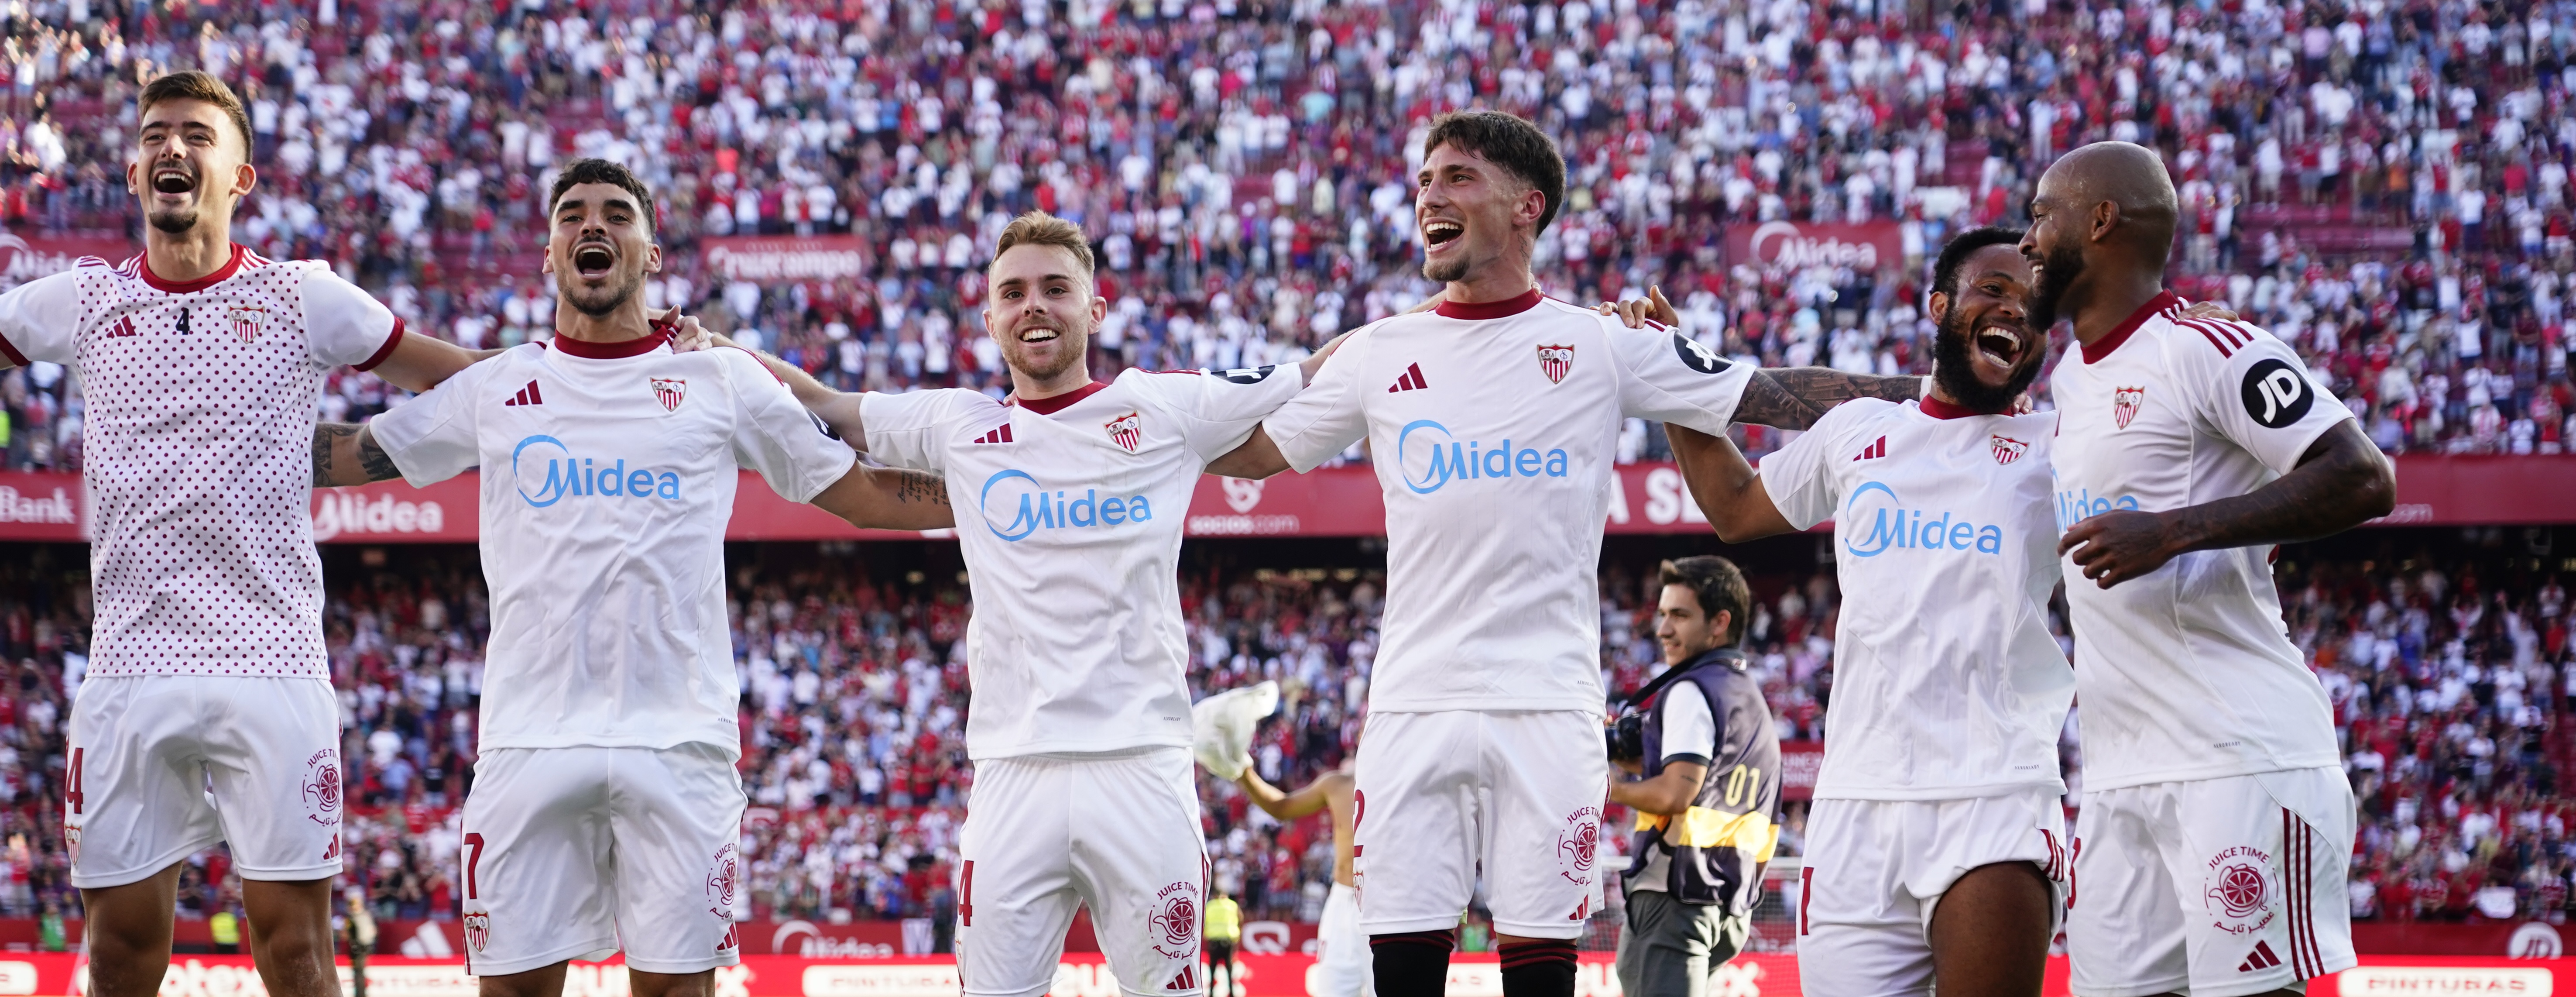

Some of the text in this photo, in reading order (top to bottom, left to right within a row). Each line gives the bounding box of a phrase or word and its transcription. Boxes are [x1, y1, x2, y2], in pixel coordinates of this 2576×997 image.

[175, 308, 190, 335] 4
[2257, 368, 2302, 423] JD
[533, 457, 680, 508] Midea
[1419, 439, 1568, 494] Midea
[0, 485, 75, 524] Bank
[313, 492, 444, 542] Midea
[1004, 489, 1152, 541] Midea
[1860, 508, 2002, 557] Midea
[307, 749, 327, 769] JUICE
[66, 748, 84, 815] 4
[1725, 763, 1760, 810] 01
[1567, 807, 1589, 825] JUICE
[464, 833, 484, 900] 7
[714, 843, 731, 863] JUICE
[2209, 846, 2270, 871] JUICE TIME
[1157, 881, 1198, 900] JUICE TIME
[2213, 921, 2245, 935] تايم
[2367, 976, 2528, 992] PINTURAS
